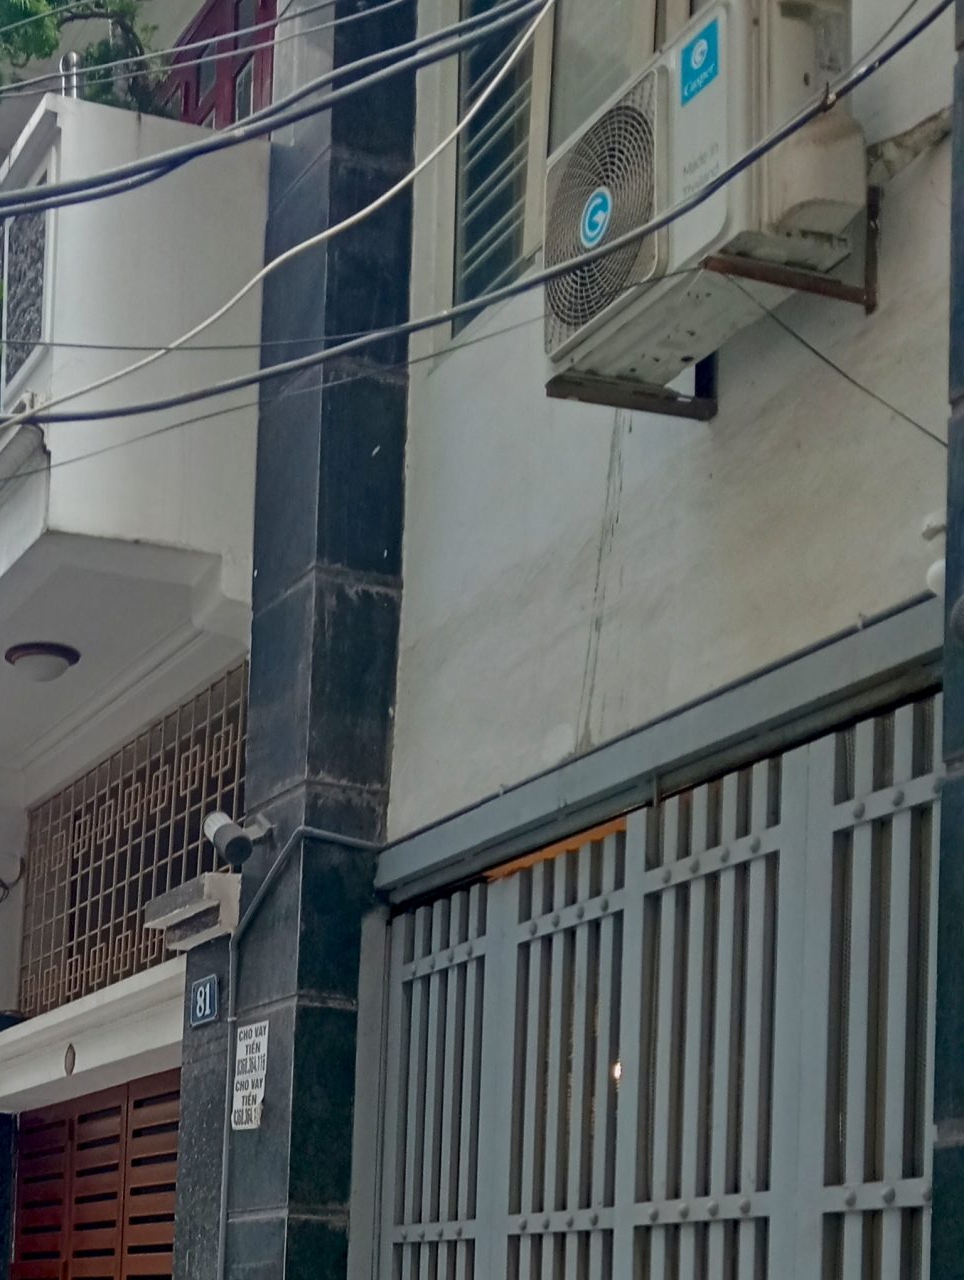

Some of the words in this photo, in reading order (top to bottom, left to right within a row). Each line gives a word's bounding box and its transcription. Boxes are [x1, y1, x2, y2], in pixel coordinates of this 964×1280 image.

[196, 982, 212, 1017] 81
[238, 1028, 253, 1042] CHO
[254, 1024, 267, 1038] VAY
[235, 1079, 249, 1093] CHO
[251, 1077, 263, 1090] VAY
